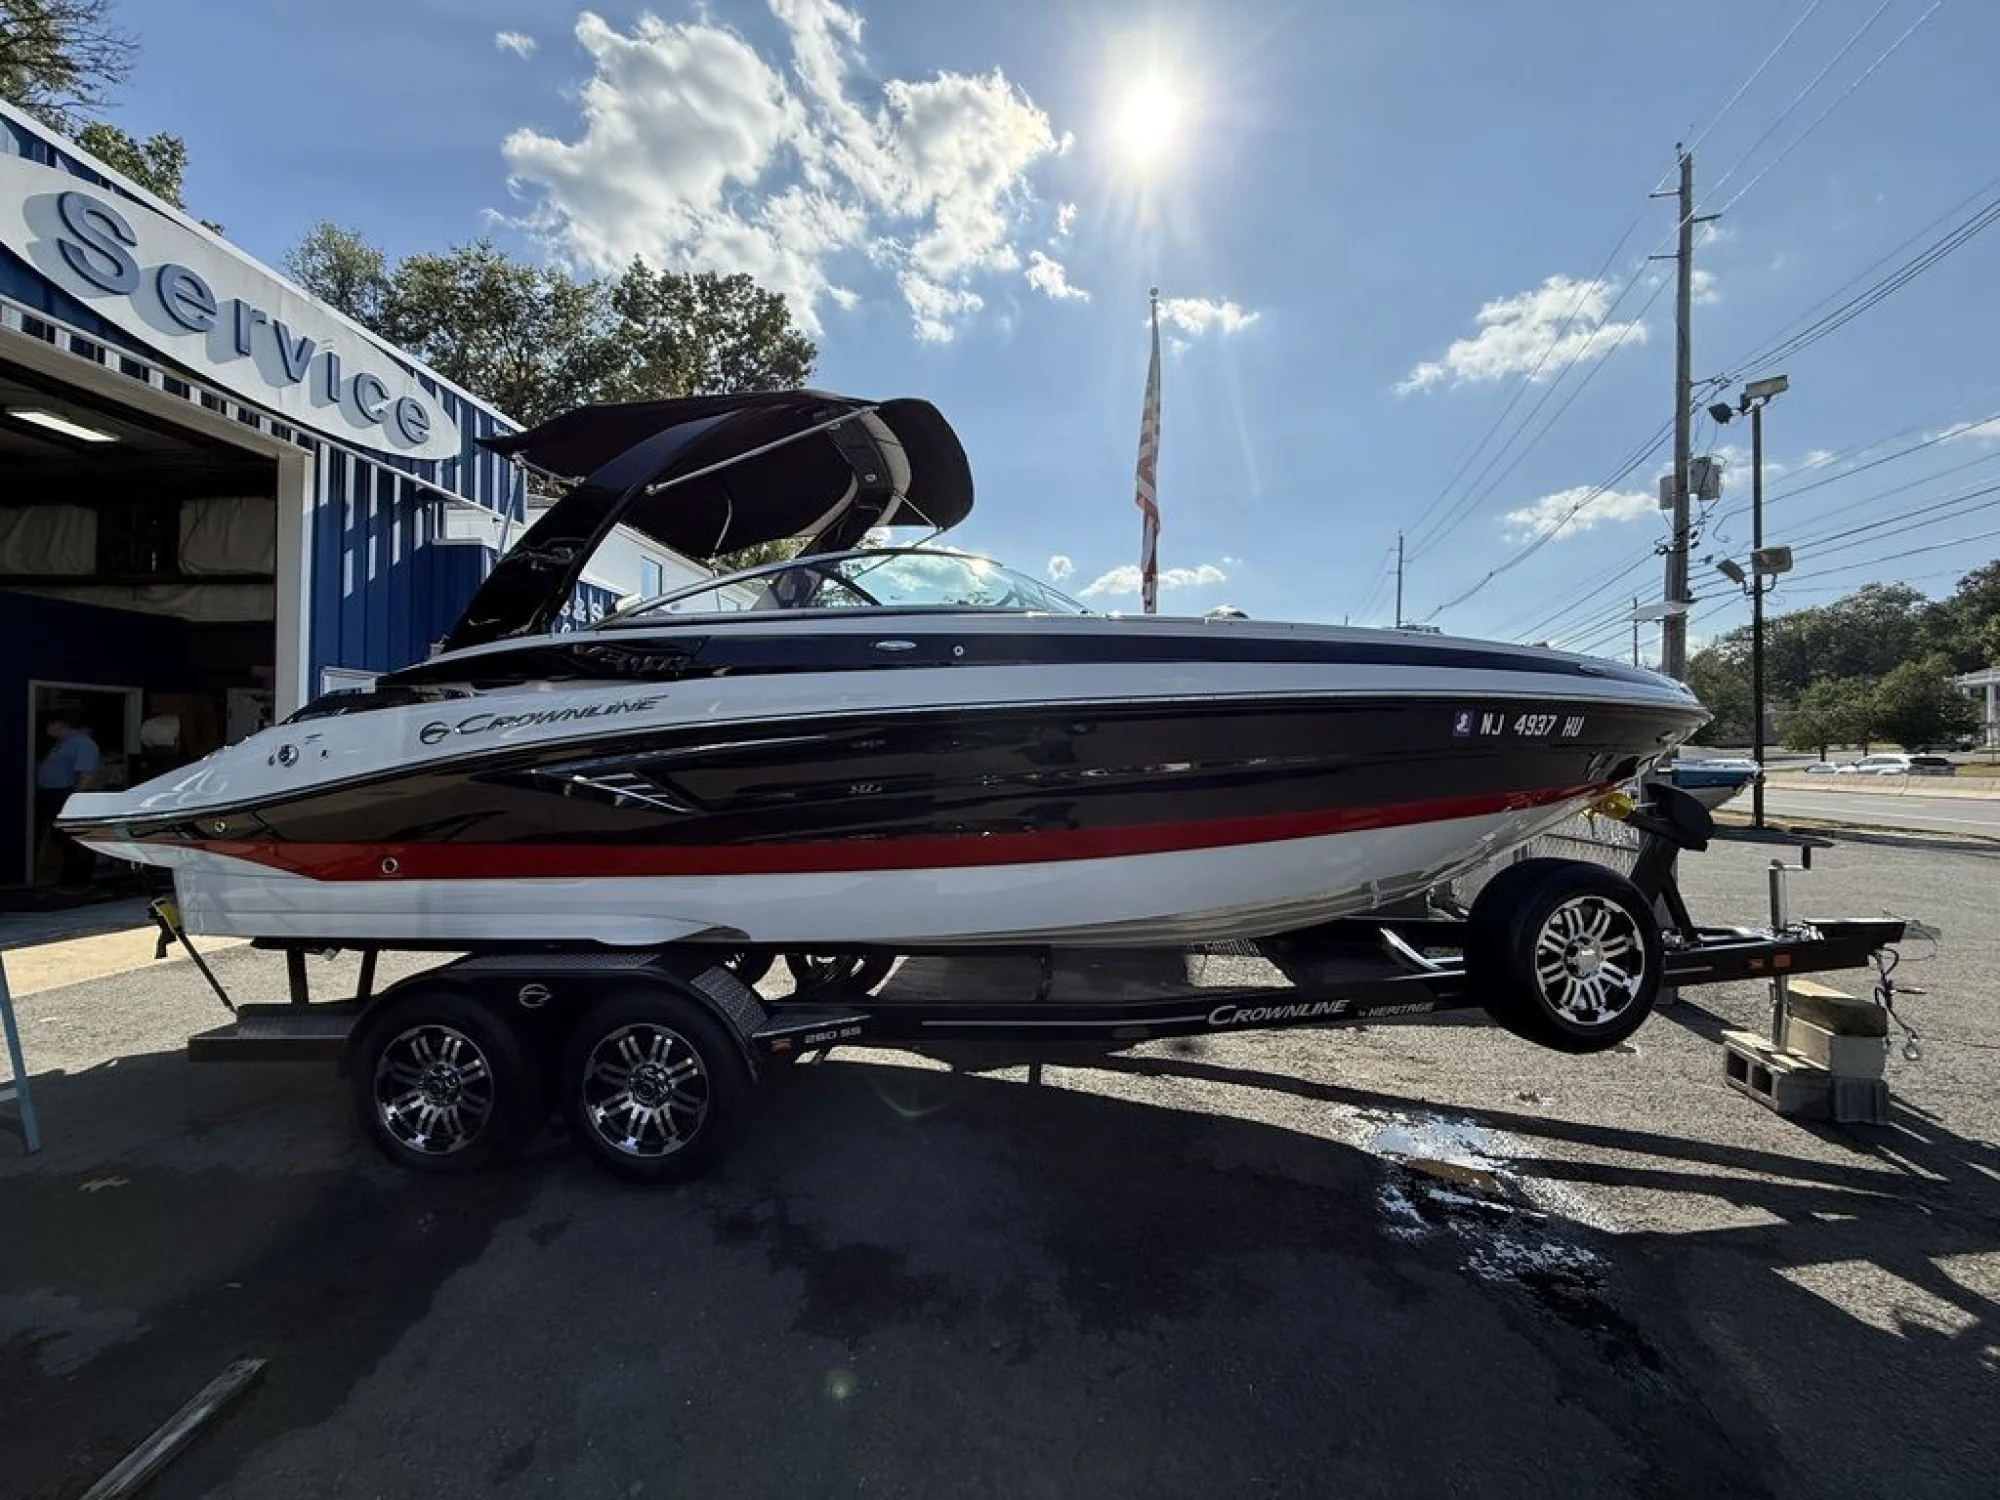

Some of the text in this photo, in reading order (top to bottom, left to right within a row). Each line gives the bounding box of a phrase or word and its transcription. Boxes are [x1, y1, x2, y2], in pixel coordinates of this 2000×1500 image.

[57, 190, 431, 445] Service
[454, 694, 668, 735] CROWNLINE
[1480, 712, 1585, 737] NJ 4937 HU
[1208, 1000, 1351, 1025] CROWNLINE
